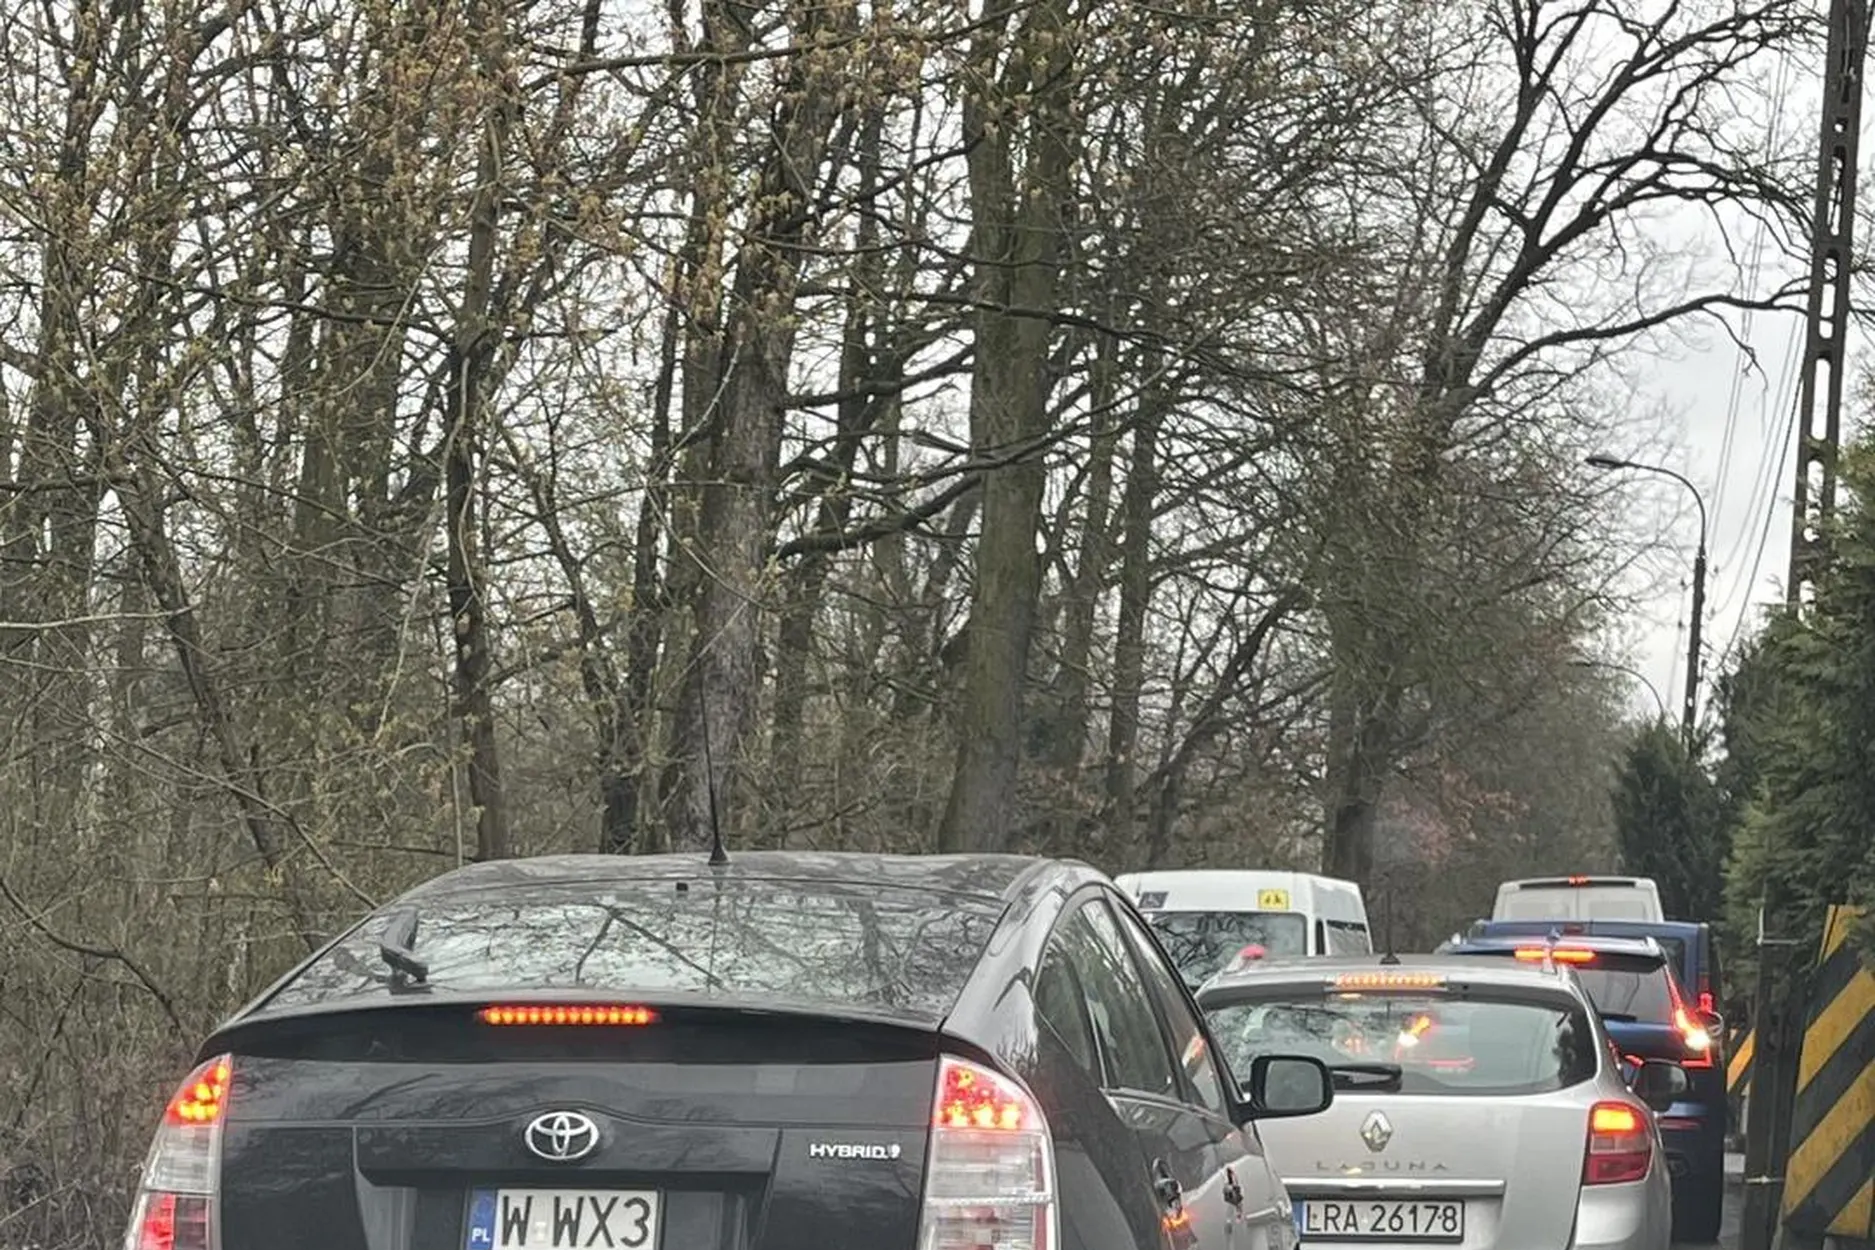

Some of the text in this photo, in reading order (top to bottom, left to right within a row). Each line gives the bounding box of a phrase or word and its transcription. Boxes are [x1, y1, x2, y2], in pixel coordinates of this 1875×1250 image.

[809, 1143, 889, 1159] HYBRID
[502, 1195, 651, 1248] W WX3
[1306, 1203, 1457, 1233] LRA 26178
[471, 1227, 491, 1242] PL
